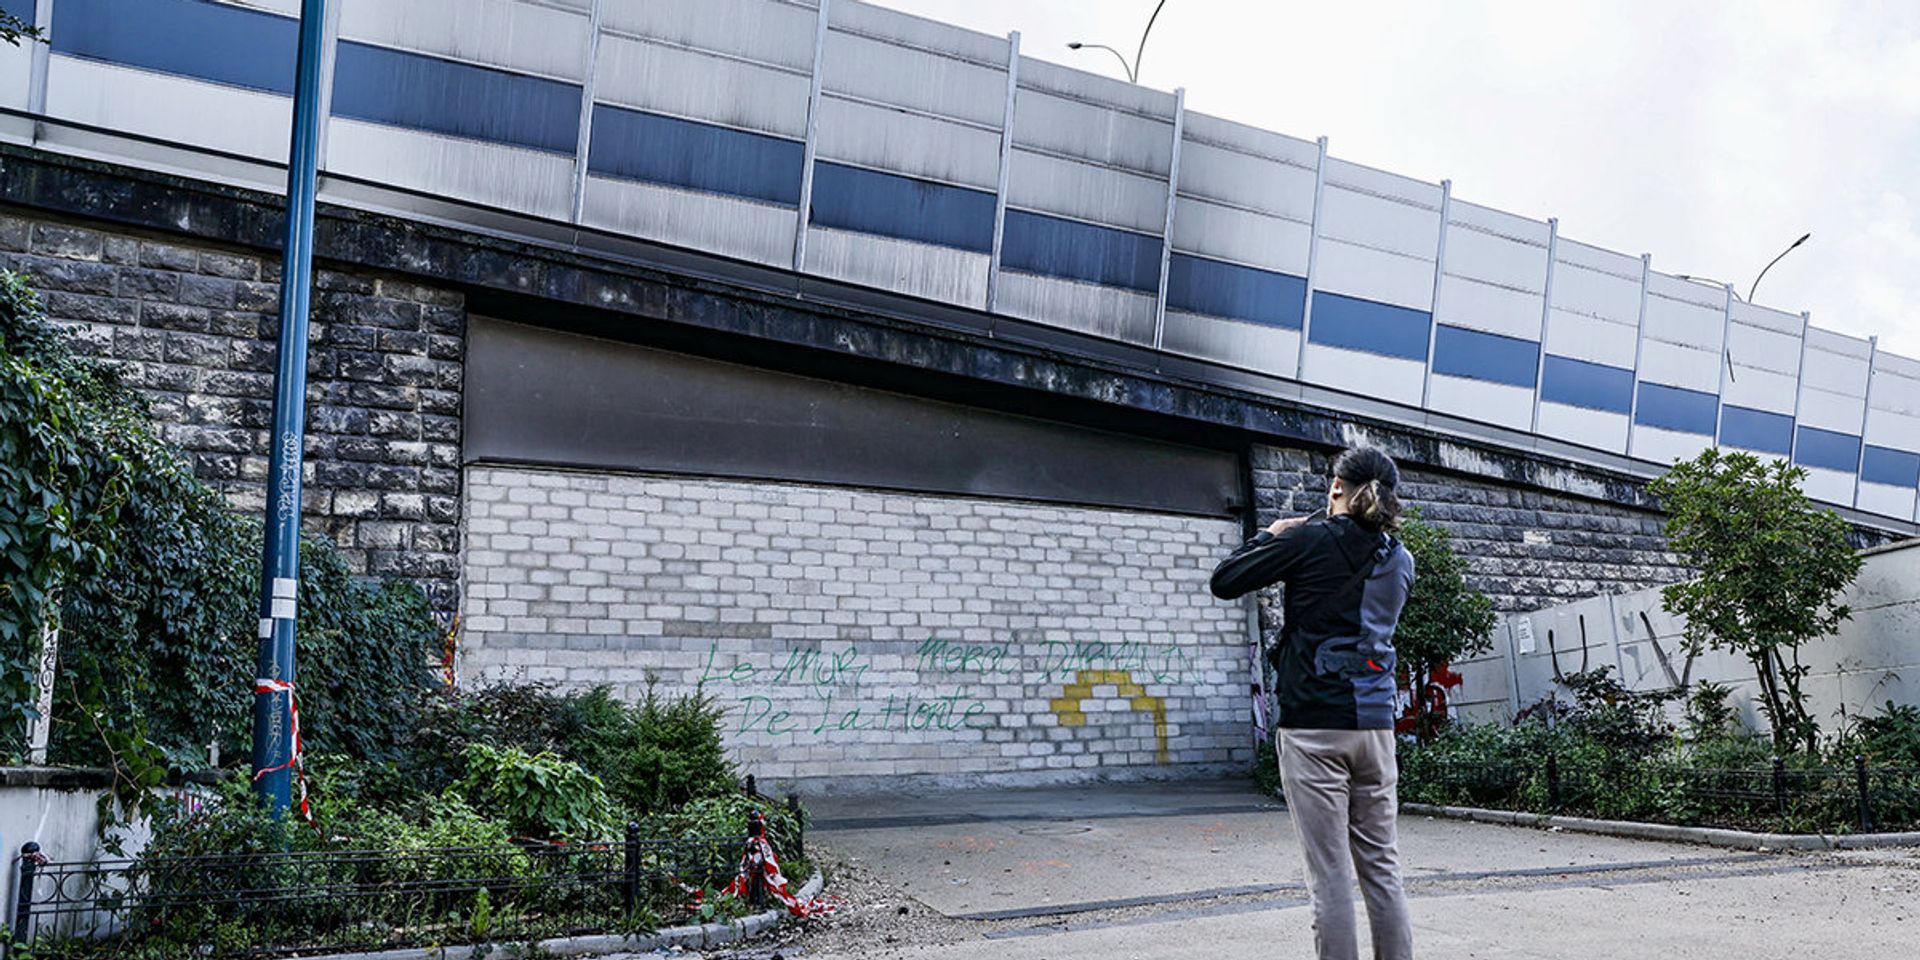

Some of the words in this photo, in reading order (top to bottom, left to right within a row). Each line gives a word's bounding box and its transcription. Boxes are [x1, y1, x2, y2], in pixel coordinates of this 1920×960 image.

[702, 642, 757, 683] Le
[735, 695, 799, 737] De
[813, 689, 871, 735] La
[880, 686, 995, 734] Honte
